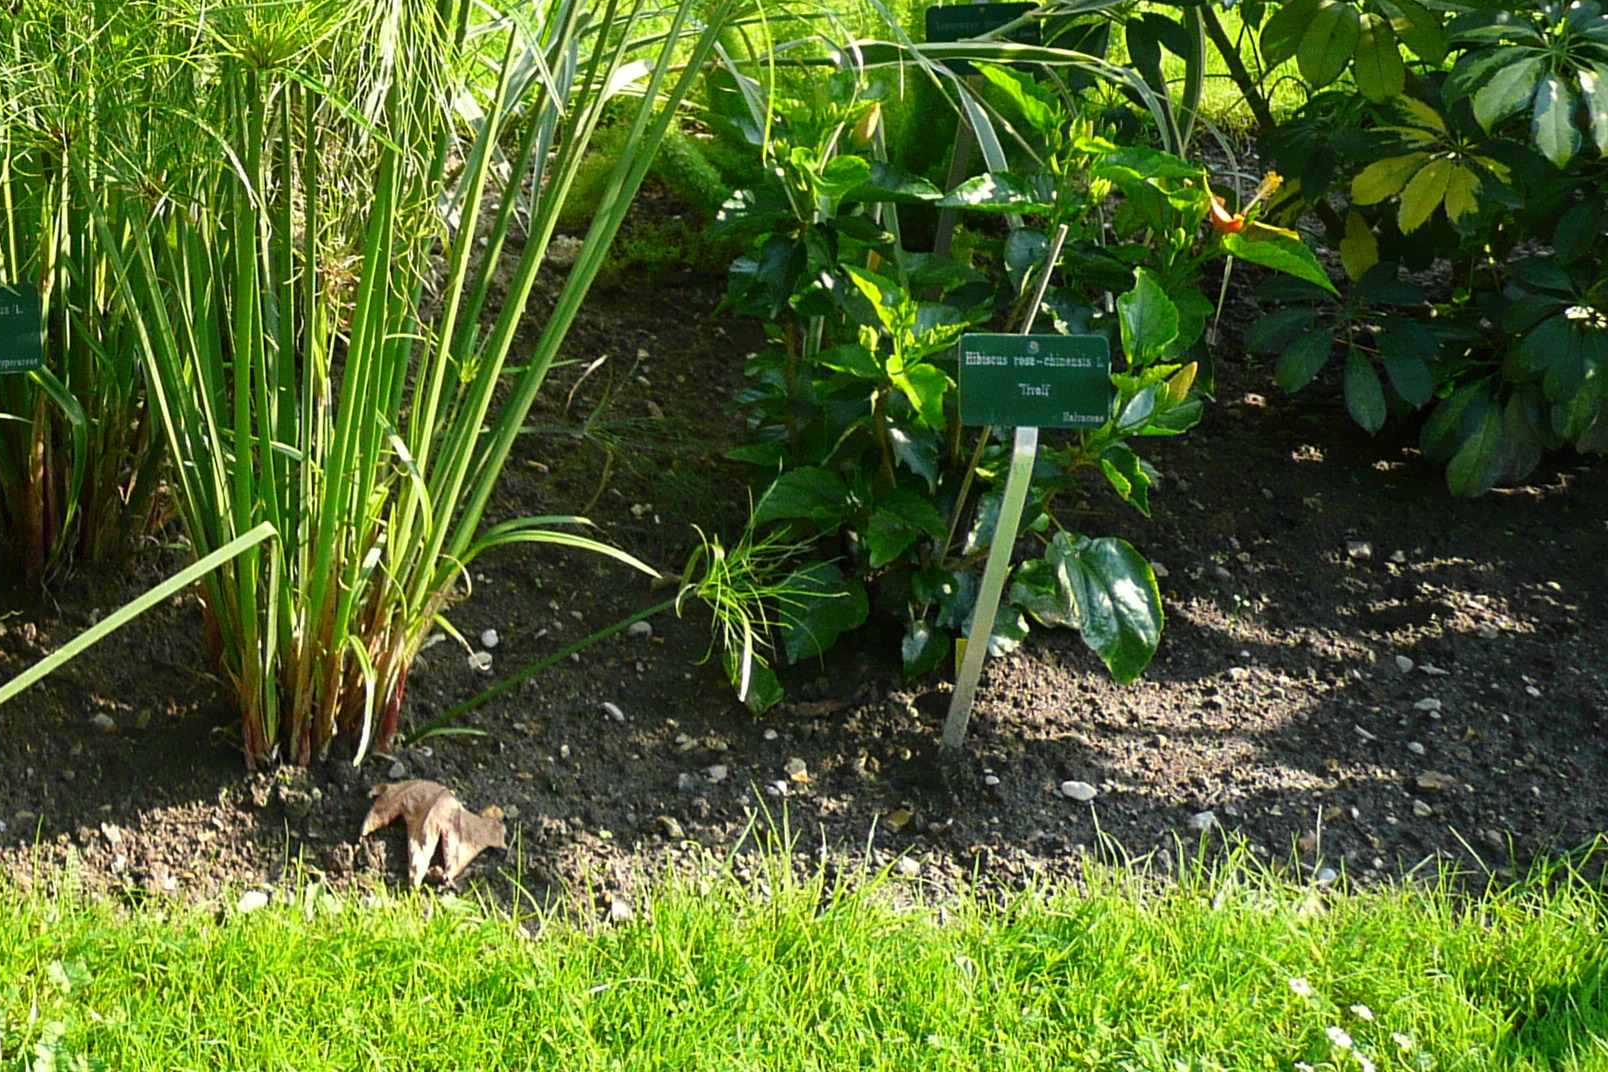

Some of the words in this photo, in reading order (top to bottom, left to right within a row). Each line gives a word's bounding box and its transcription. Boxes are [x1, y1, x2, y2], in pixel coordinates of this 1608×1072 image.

[965, 351, 1008, 366] Hibiscus
[1013, 353, 1091, 368] rosa-chinensis
[1062, 410, 1105, 423] Malvaceae
